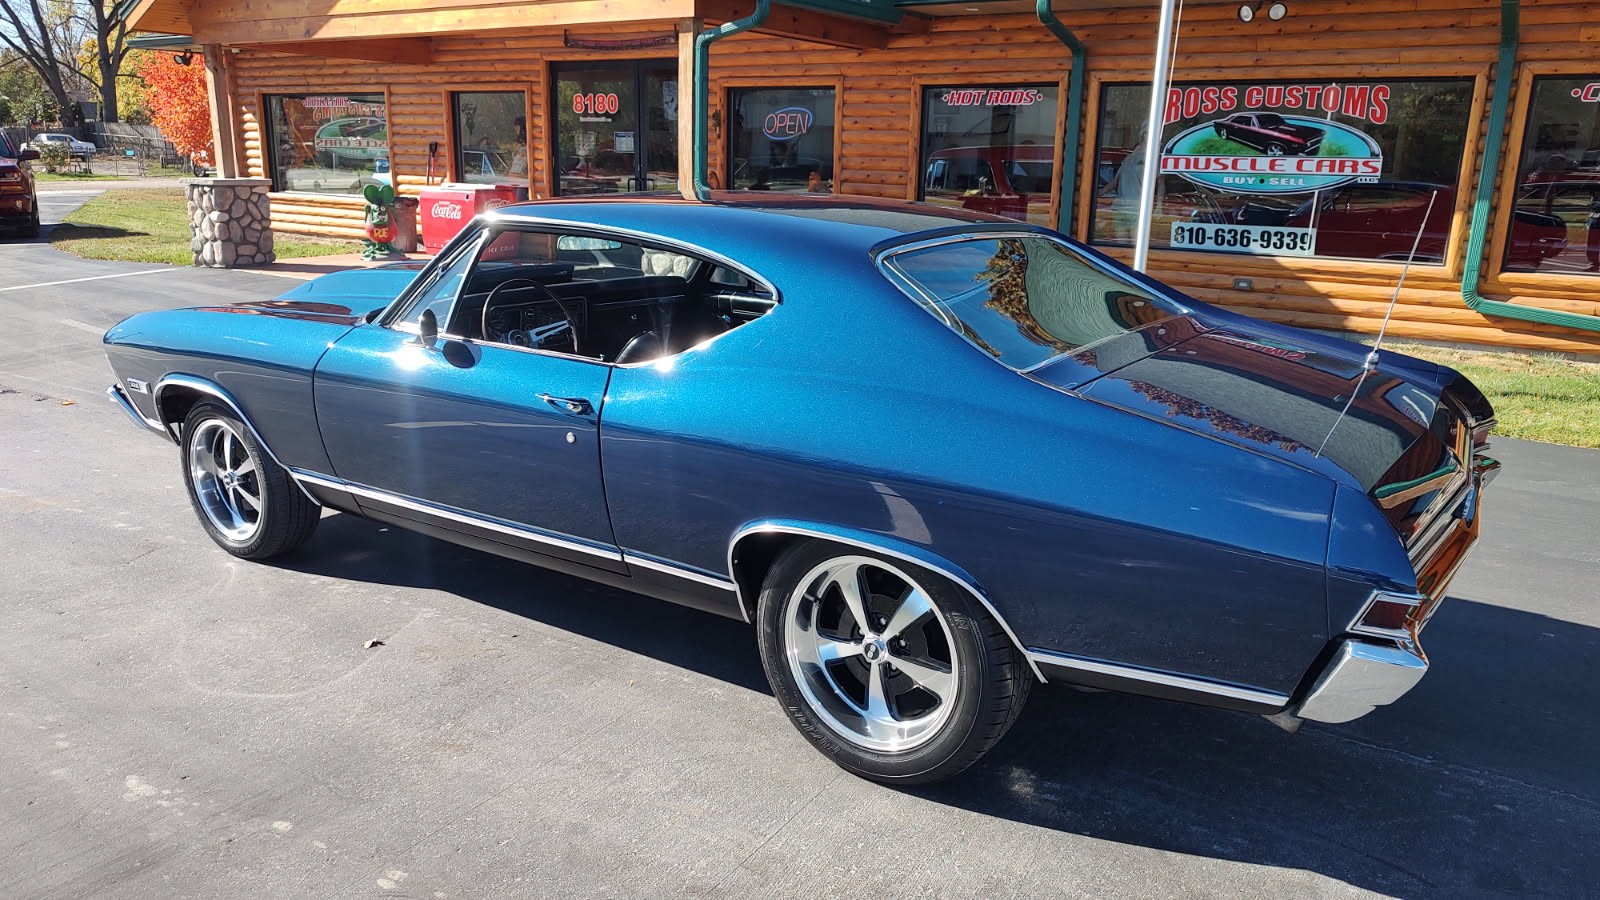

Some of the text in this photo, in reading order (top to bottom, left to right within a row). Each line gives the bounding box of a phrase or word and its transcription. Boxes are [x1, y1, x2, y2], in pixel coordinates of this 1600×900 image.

[573, 93, 618, 114] 8180
[948, 90, 1037, 106] HOT RODS
[1165, 85, 1390, 125] ROSS CUSTOMS
[764, 113, 809, 134] OPEN
[1161, 157, 1381, 175] MUSCLE CARS
[1222, 176, 1306, 186] BUY SELL
[1174, 226, 1313, 250] 810-636-9339
